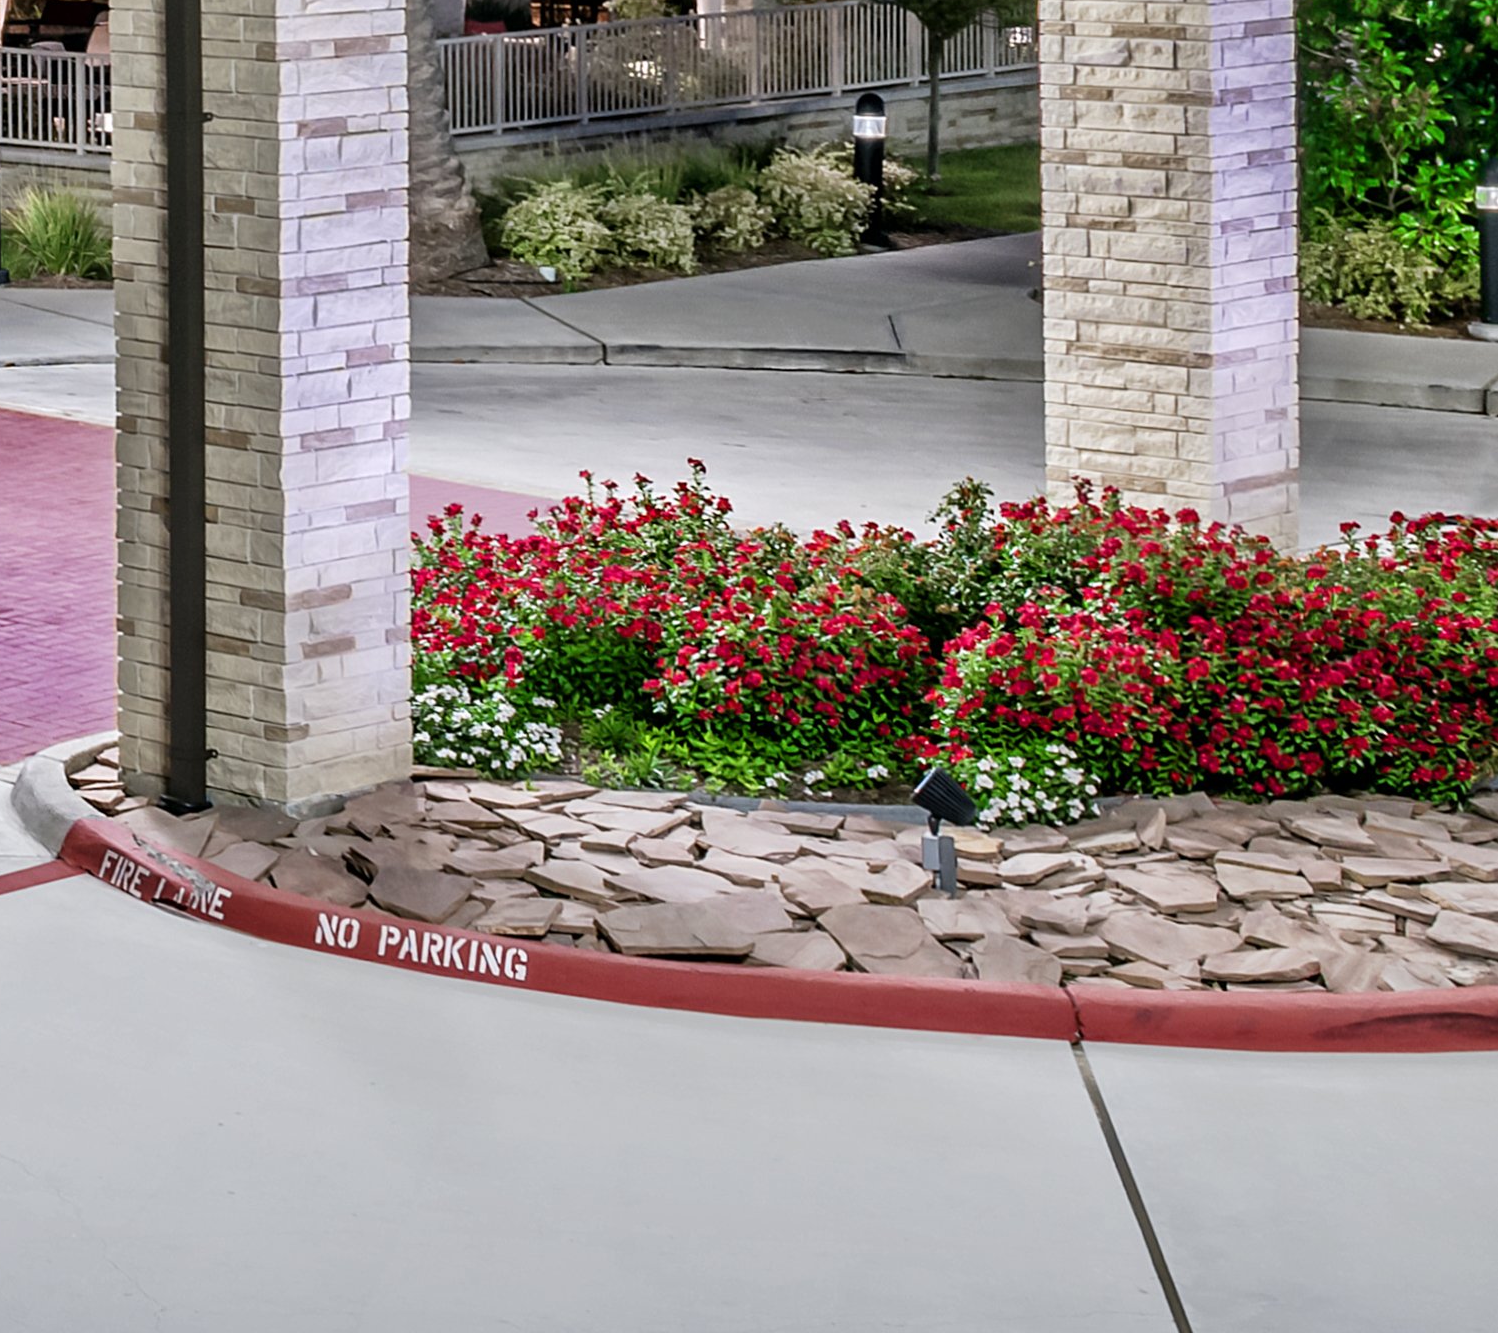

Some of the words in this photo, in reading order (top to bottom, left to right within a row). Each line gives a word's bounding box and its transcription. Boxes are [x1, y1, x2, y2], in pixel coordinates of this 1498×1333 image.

[98, 848, 151, 899] FIRE
[314, 912, 361, 950] NO
[377, 924, 529, 982] PARKING
